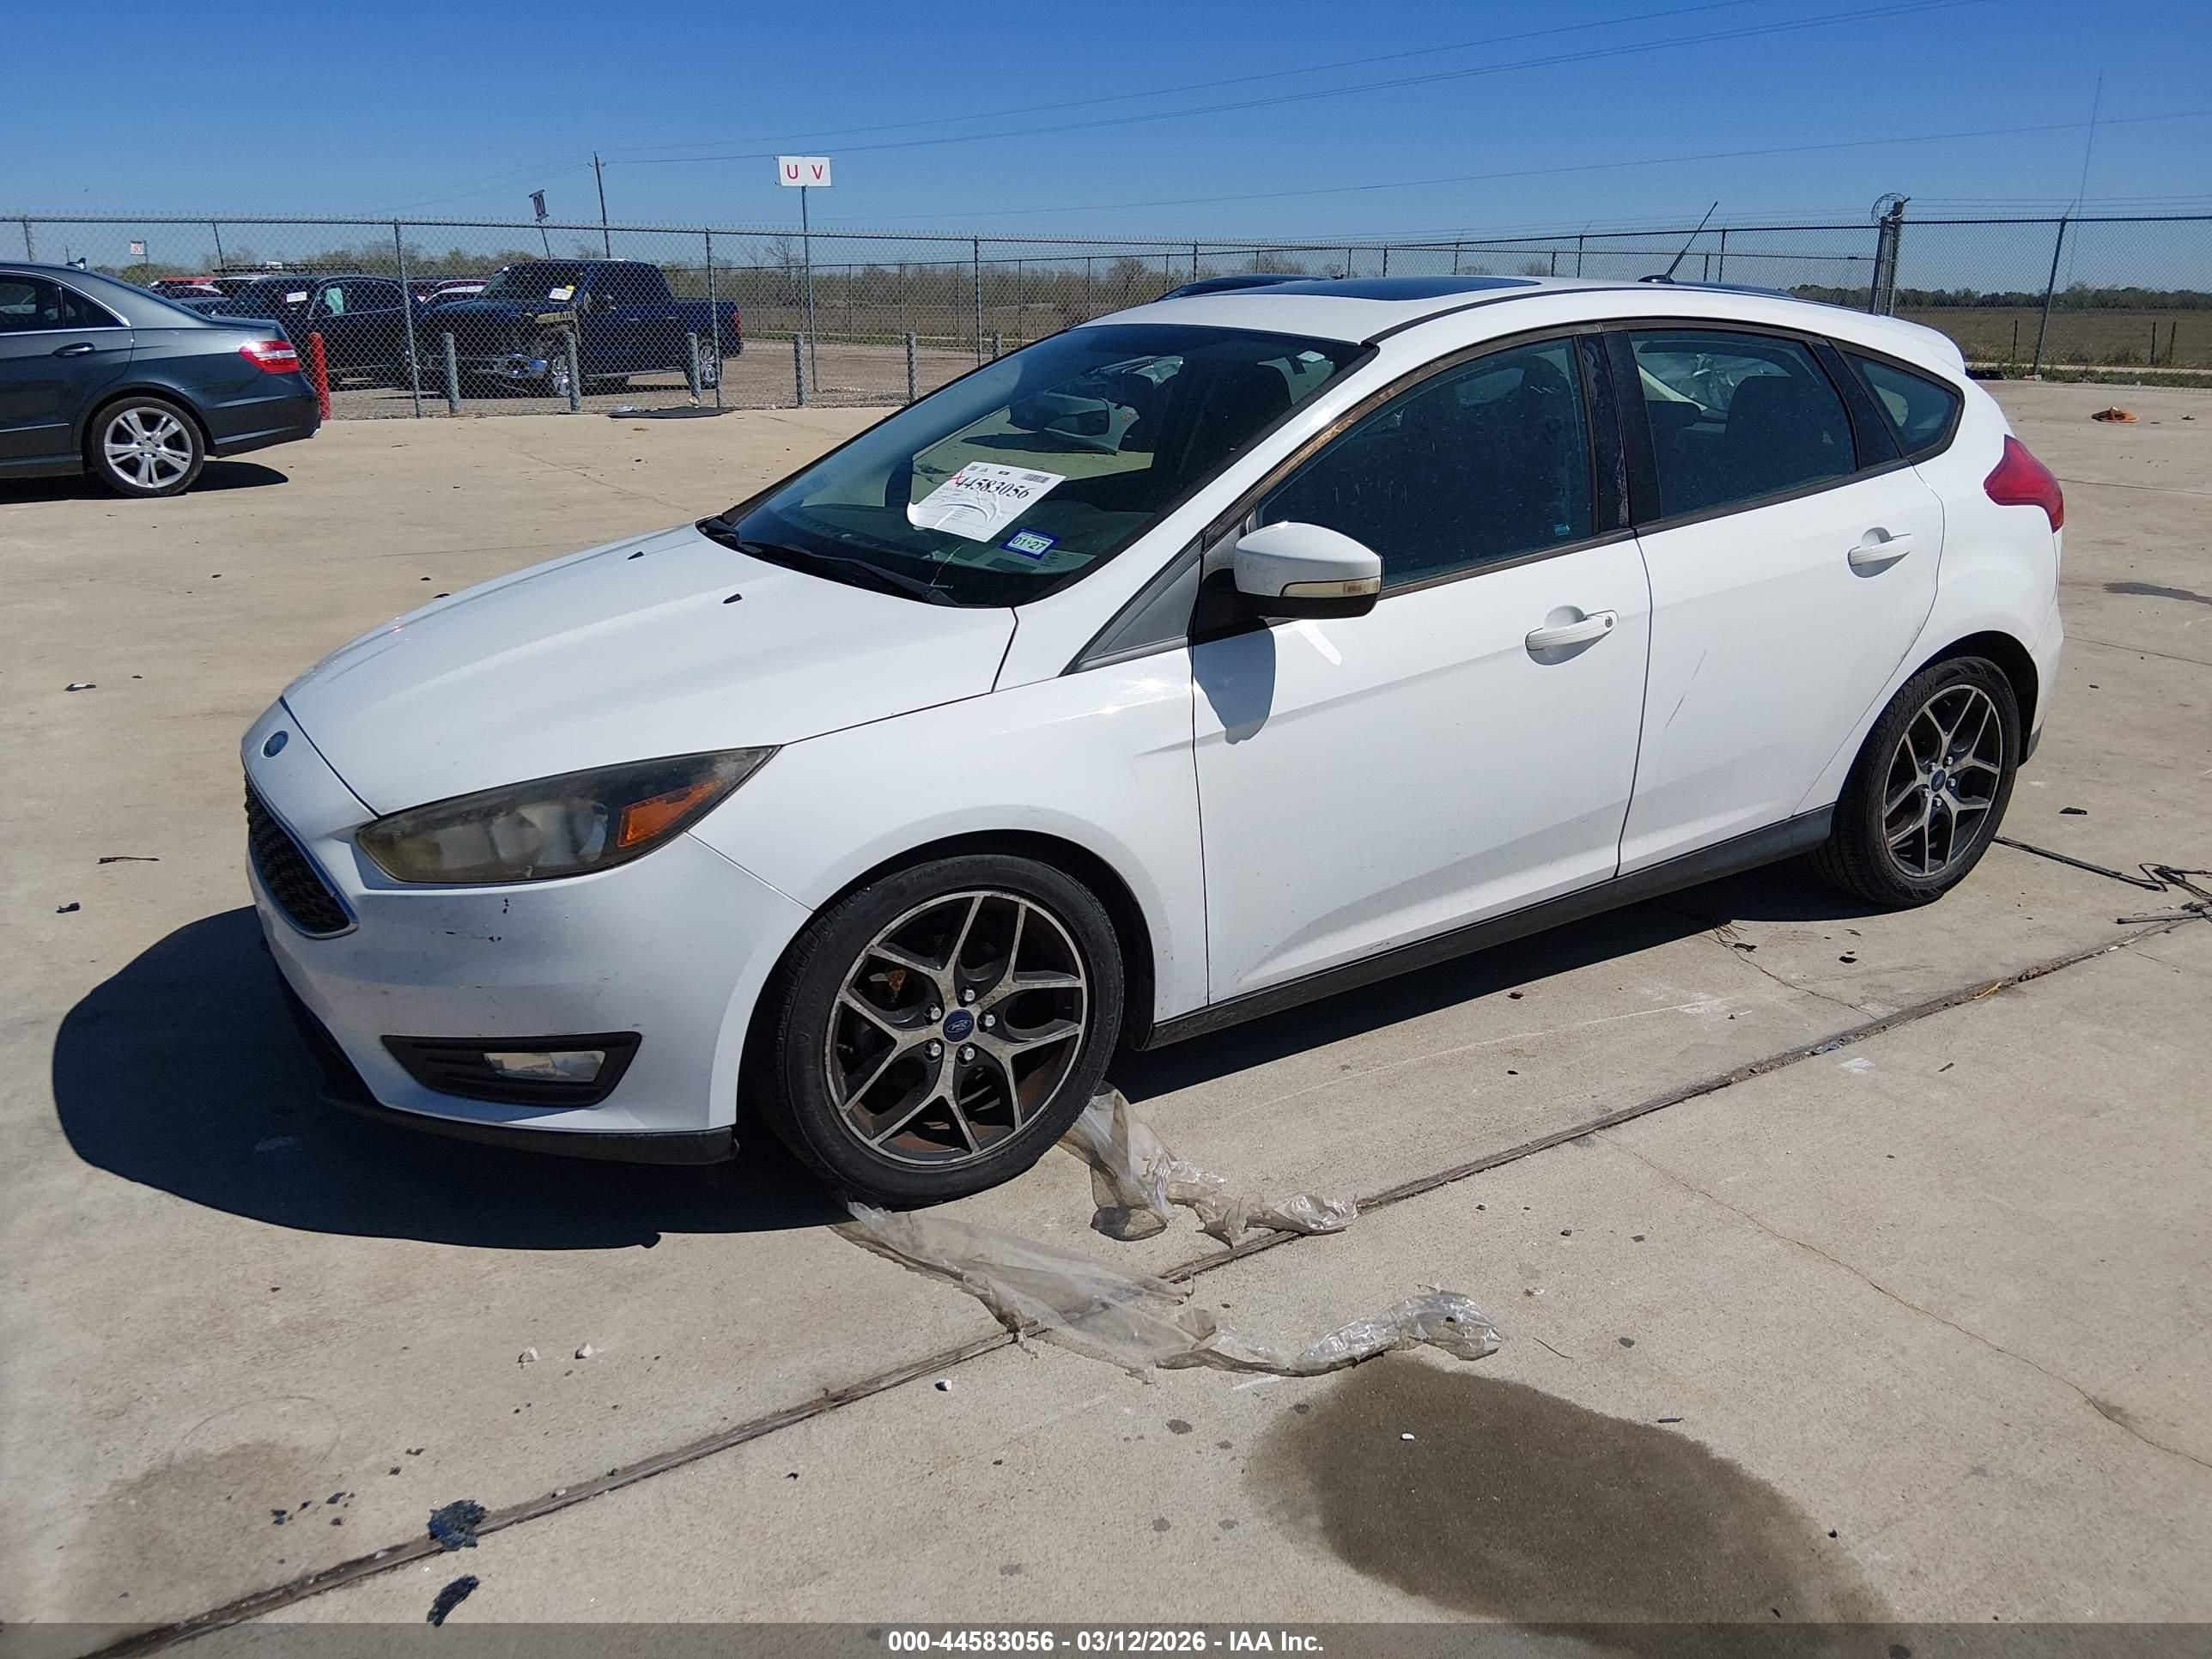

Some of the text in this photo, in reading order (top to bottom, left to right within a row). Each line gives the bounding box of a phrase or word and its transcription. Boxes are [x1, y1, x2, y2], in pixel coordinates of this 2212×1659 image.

[787, 165, 823, 179] U V
[955, 477, 1036, 499] 44583056
